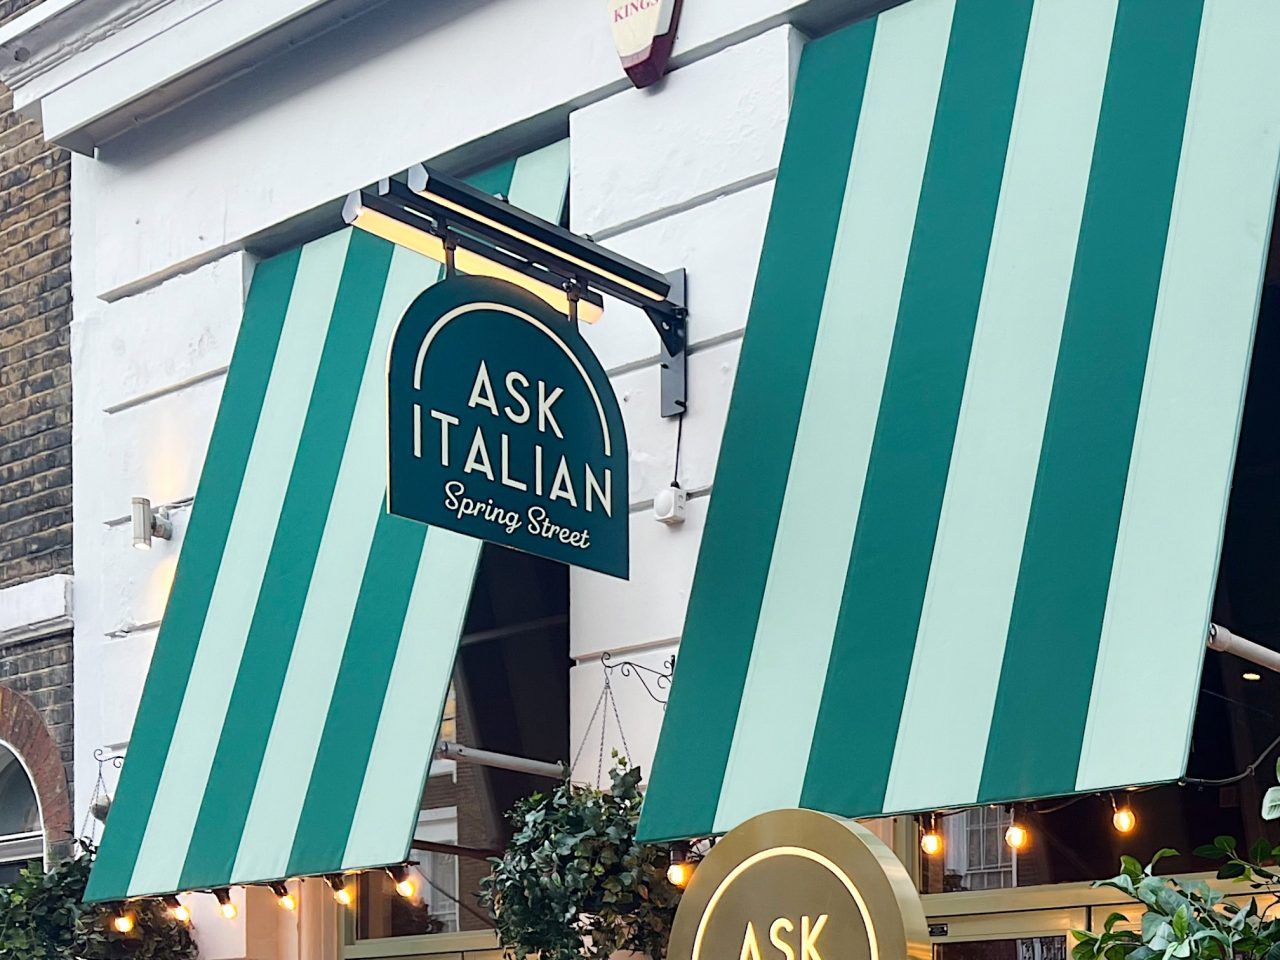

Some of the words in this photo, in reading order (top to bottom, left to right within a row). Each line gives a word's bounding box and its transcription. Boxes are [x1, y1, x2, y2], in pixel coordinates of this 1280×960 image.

[467, 359, 565, 440] ASK
[413, 403, 612, 518] ITALIAN
[444, 480, 522, 534] Spring
[527, 506, 591, 550] Street
